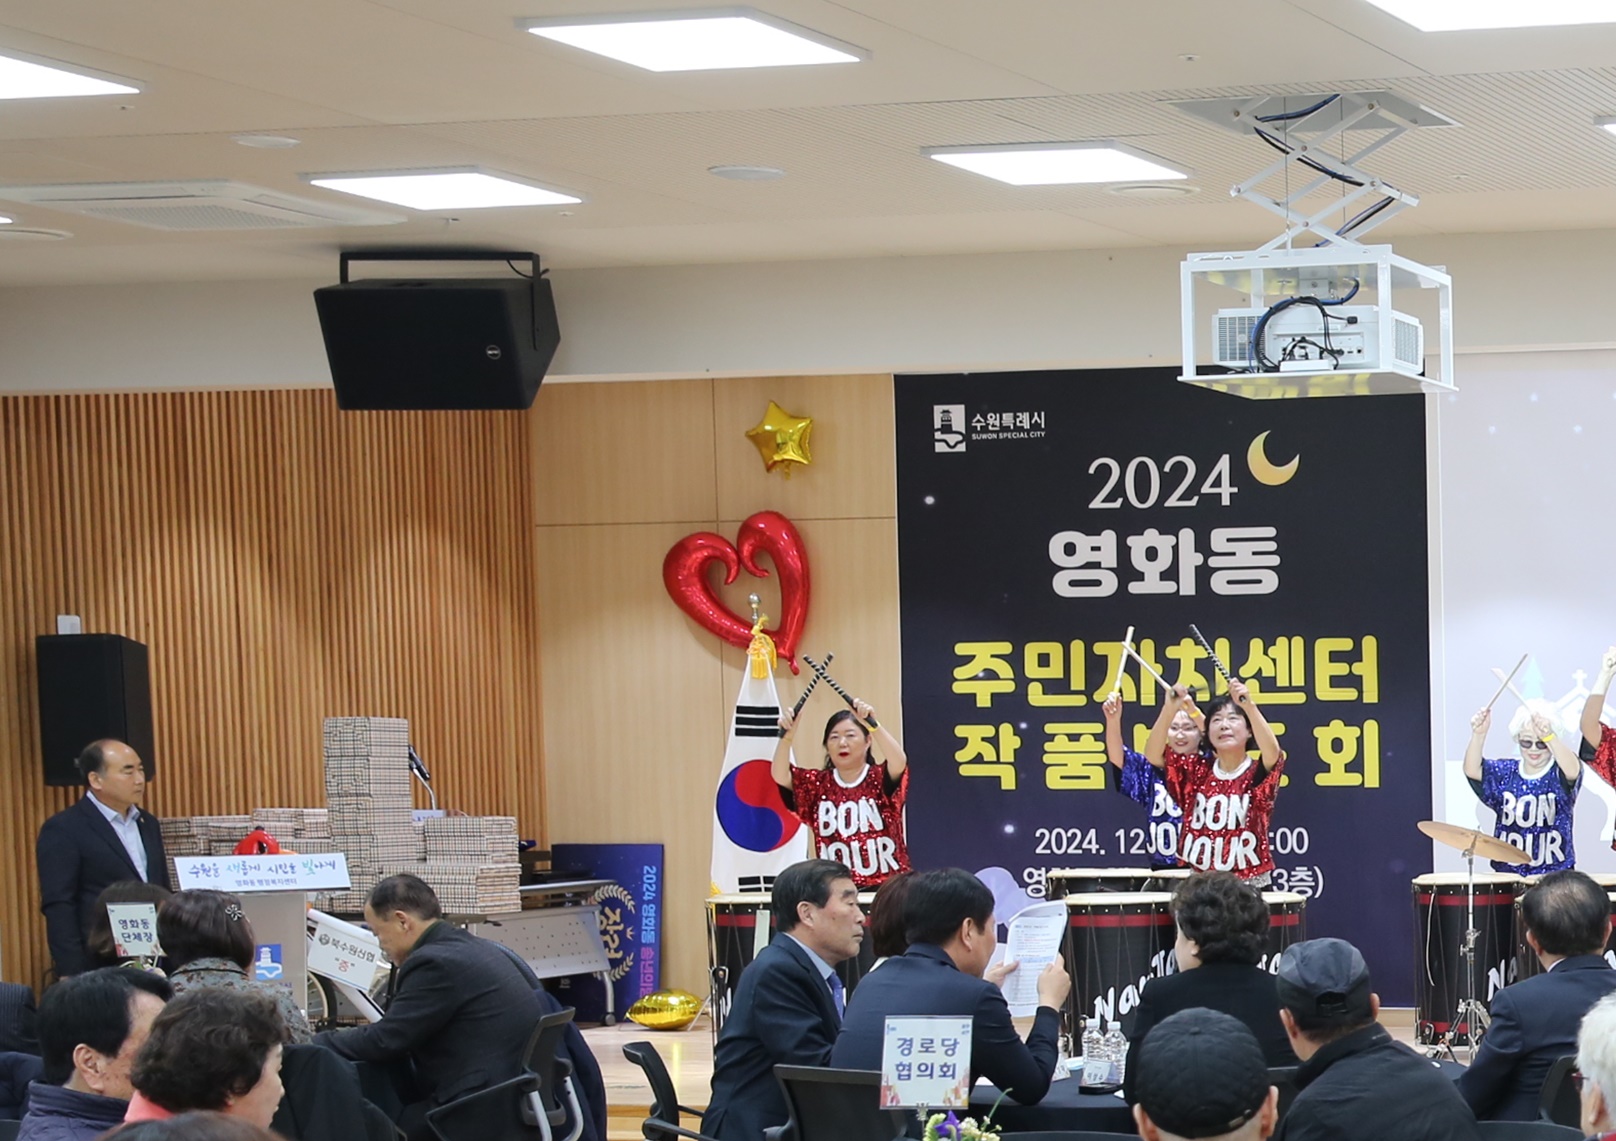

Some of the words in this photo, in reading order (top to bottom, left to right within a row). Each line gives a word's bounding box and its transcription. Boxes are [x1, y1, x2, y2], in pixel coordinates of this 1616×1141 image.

[971, 411, 1045, 431] 수원특례시
[971, 432, 998, 440] SUWON
[1088, 453, 1238, 509] 2024
[1048, 526, 1281, 599] 영화동
[951, 634, 1379, 707] 주민자치센터
[1152, 783, 1183, 817] BO
[1191, 792, 1250, 831] BON
[1502, 791, 1557, 828] BON
[818, 798, 884, 837] BON
[1035, 827, 1106, 855] 2024.
[642, 865, 657, 901] 2024
[118, 918, 150, 930] 영화동
[121, 932, 153, 943] 단체장
[896, 1037, 960, 1057] 경로당
[895, 1062, 957, 1081] 협의회
